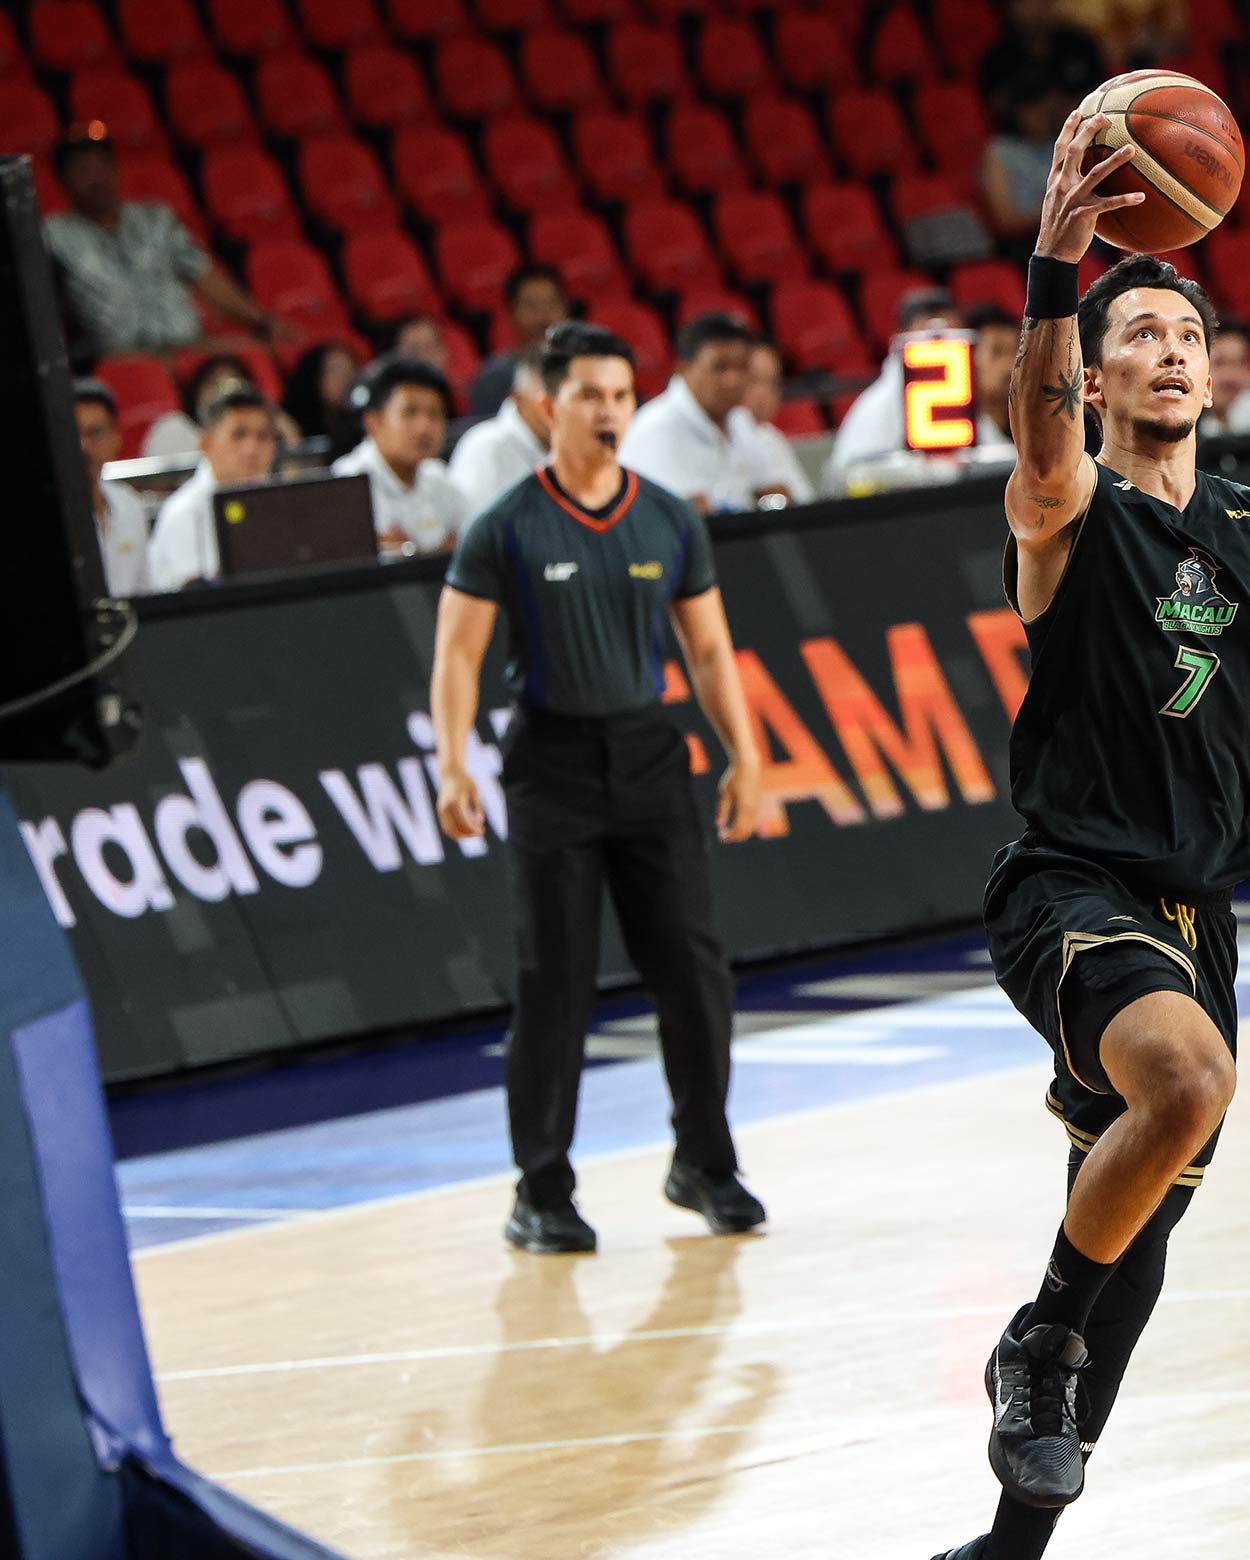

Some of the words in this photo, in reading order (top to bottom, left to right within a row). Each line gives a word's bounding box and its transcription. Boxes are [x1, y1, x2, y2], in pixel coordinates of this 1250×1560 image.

[903, 338, 975, 449] 2
[1158, 600, 1235, 624] MACAU
[1159, 645, 1221, 719] 7
[318, 706, 516, 873] wit
